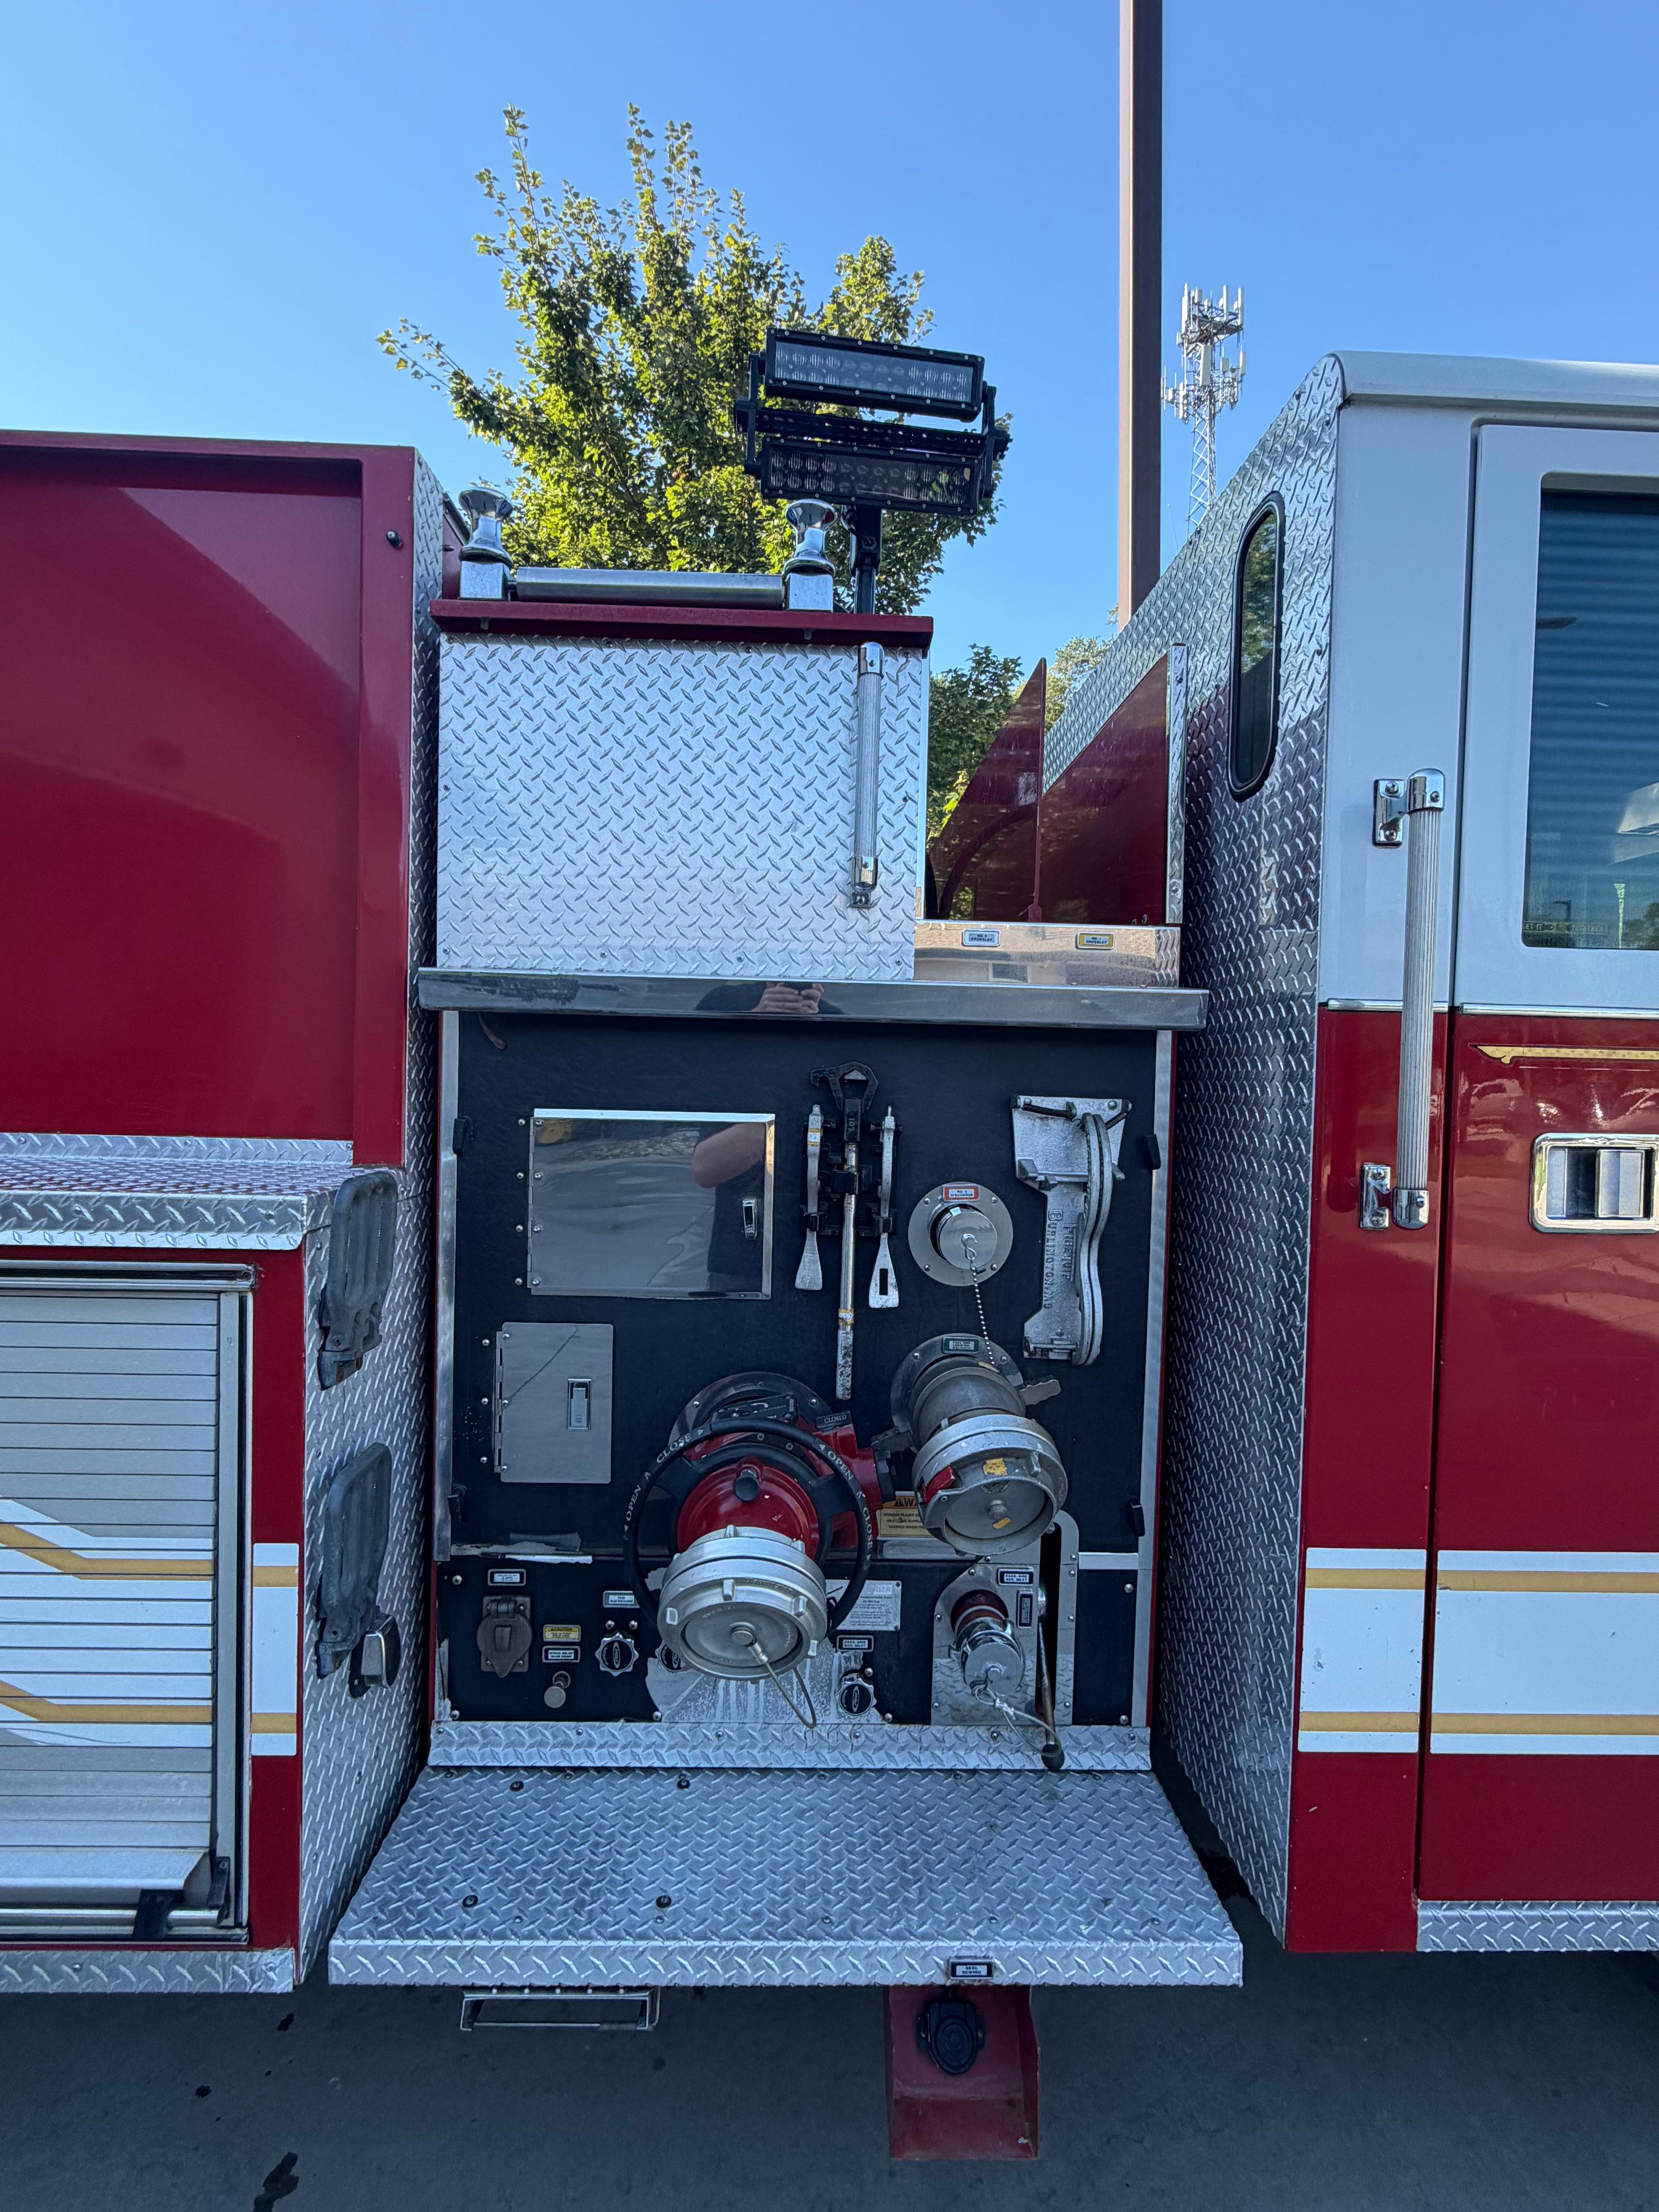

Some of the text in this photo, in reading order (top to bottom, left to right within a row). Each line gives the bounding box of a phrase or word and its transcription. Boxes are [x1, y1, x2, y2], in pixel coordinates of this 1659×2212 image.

[823, 1414, 847, 1424] CLOSED
[656, 1433, 692, 1463] CLOSE
[827, 1451, 854, 1481] OPEN
[625, 1484, 641, 1522] OPEN
[862, 1506, 873, 1550] CLOSE
